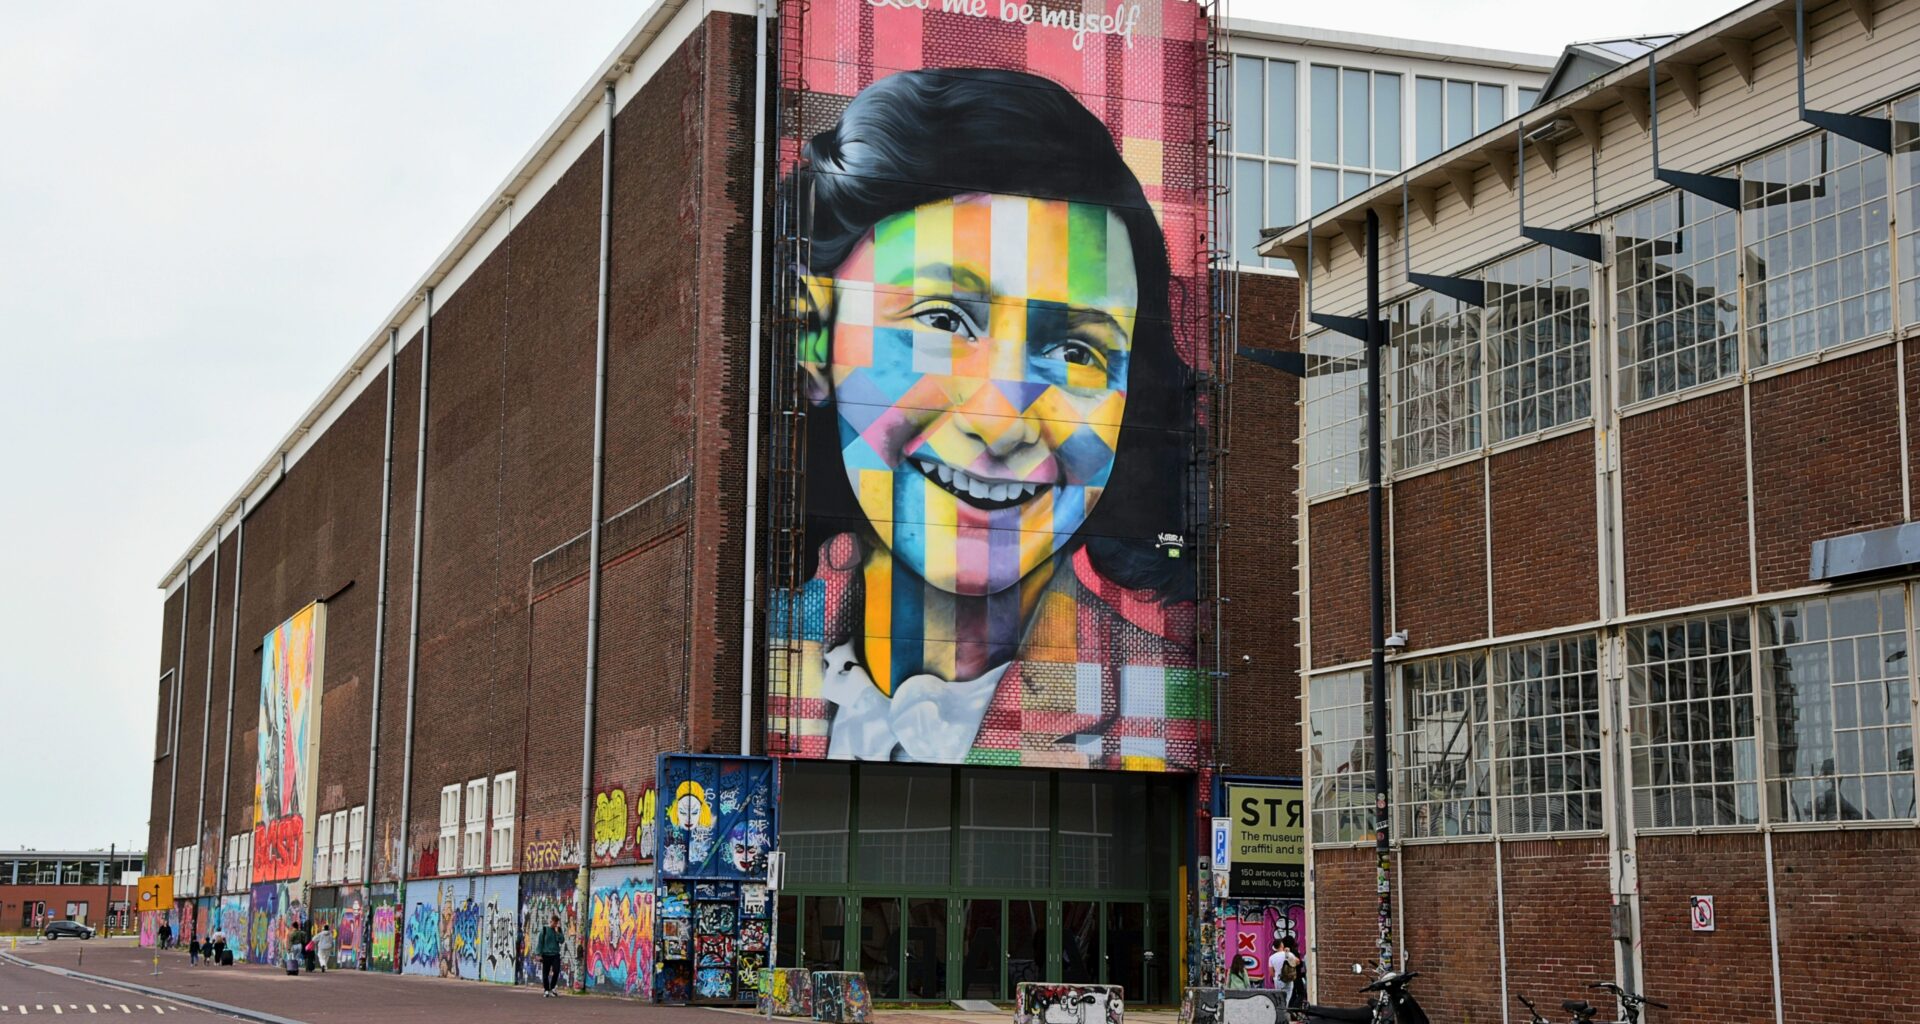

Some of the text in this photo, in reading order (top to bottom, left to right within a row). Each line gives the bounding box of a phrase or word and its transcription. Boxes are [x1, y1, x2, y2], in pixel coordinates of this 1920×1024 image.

[942, 0, 988, 17] me
[1000, 0, 1035, 24] be
[1041, 4, 1140, 51] myself
[1241, 831, 1260, 840] The
[1241, 843, 1273, 855] graffiti
[1275, 845, 1295, 854] and
[1241, 868, 1254, 876] 150
[1255, 869, 1289, 878] artworks,
[1251, 879, 1272, 887] walls,
[1272, 880, 1282, 888] by
